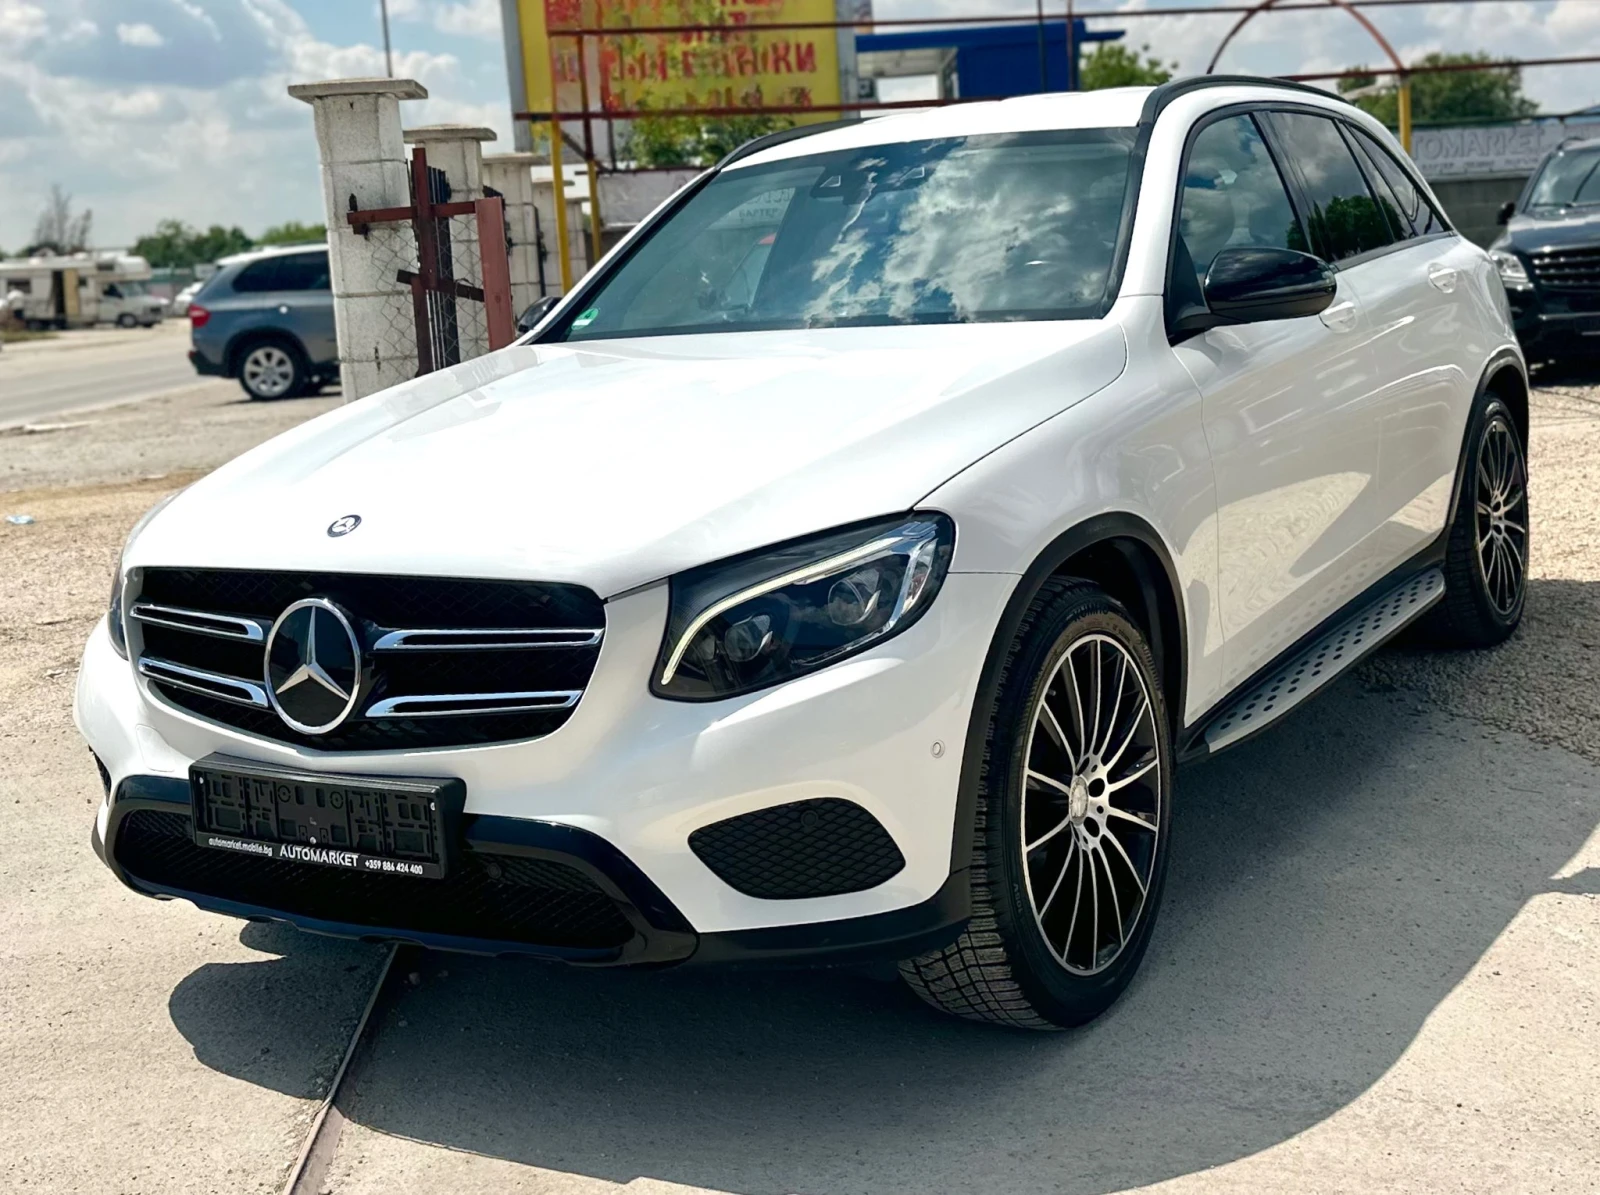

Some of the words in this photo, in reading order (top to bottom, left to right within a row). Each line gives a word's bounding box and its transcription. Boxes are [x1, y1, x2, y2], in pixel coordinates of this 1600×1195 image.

[208, 836, 273, 857] automarket.mobile.bg
[279, 844, 359, 867] AUTOMARKET
[364, 859, 382, 870] +359
[395, 862, 409, 874] 424
[409, 863, 424, 875] 400
